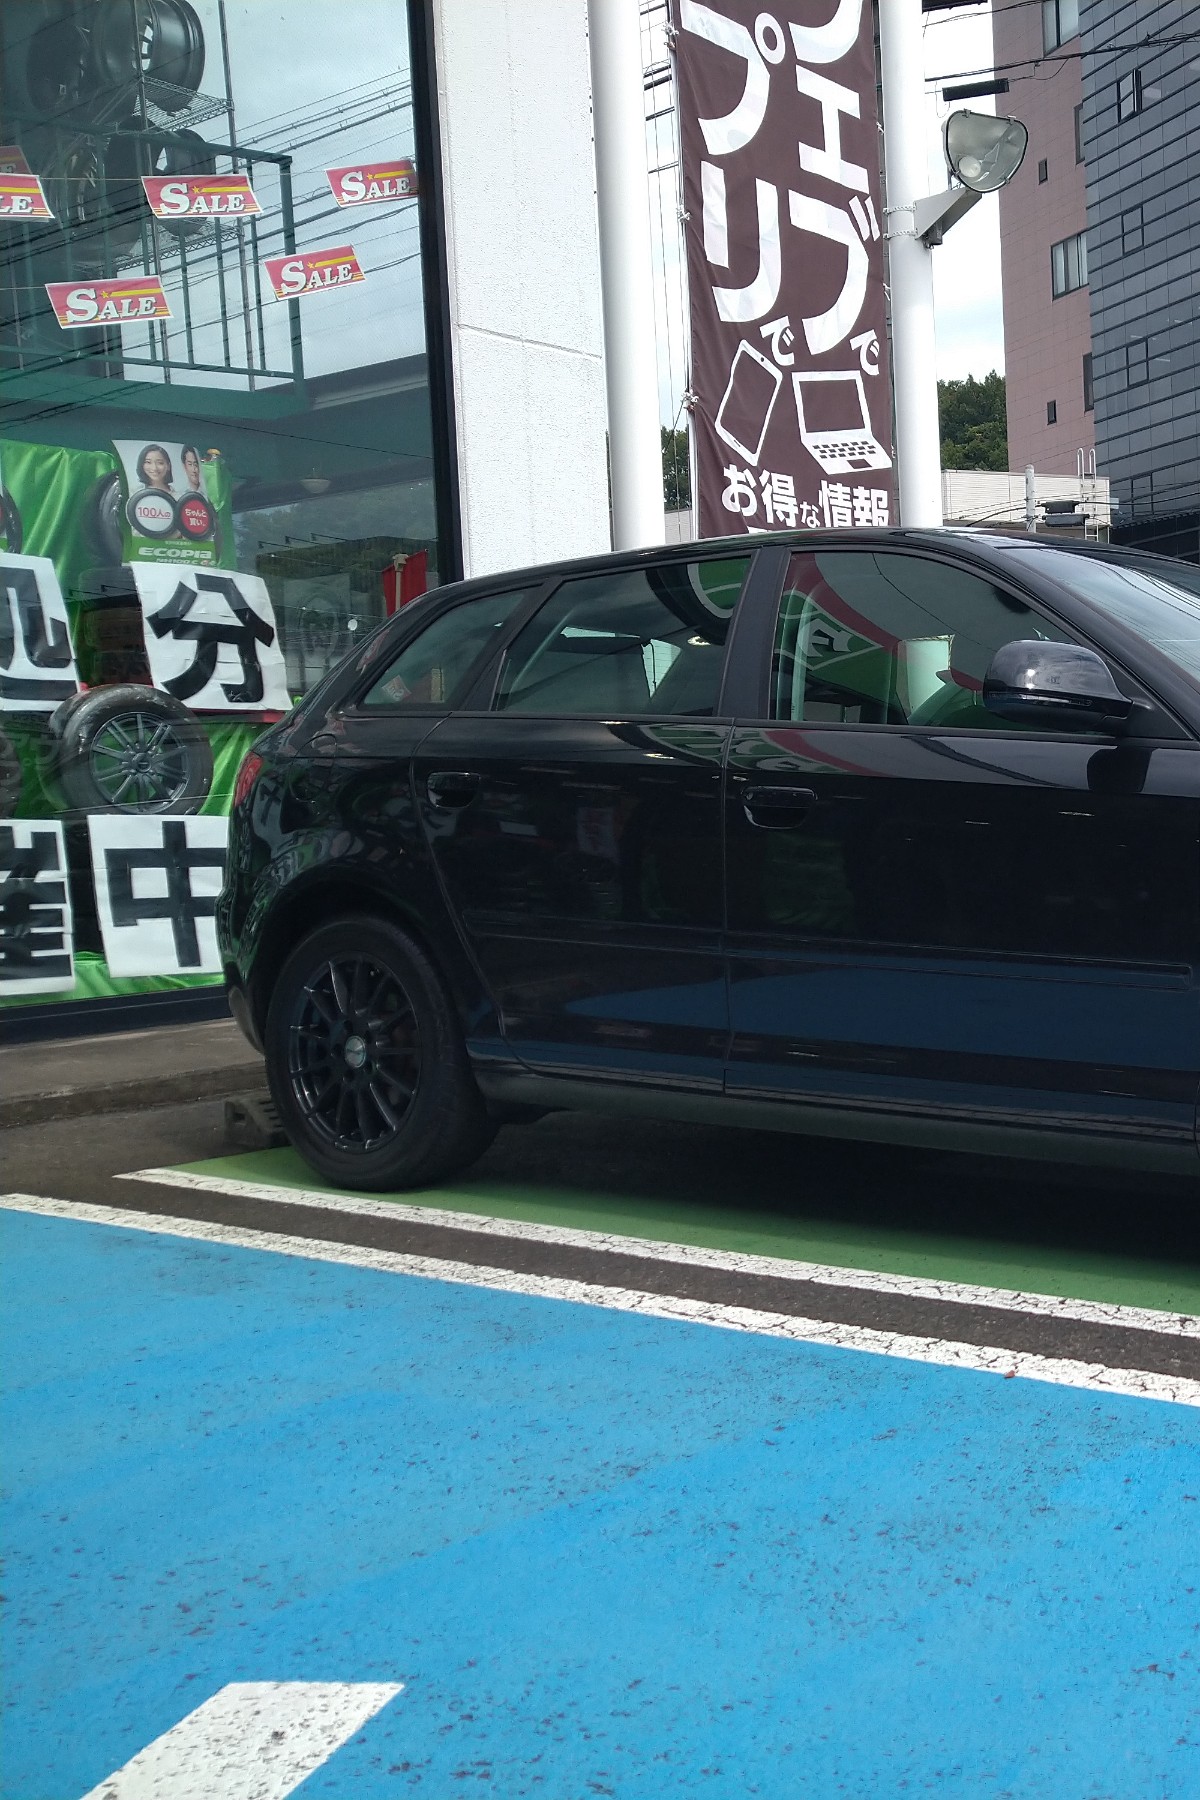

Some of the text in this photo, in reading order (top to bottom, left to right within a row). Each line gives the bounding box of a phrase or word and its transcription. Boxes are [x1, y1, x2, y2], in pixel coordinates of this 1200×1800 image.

[160, 182, 245, 214] SALE
[340, 171, 411, 202] SALE
[281, 260, 354, 294] SALE
[66, 288, 157, 322] SALE
[722, 464, 890, 528] お得な情報
